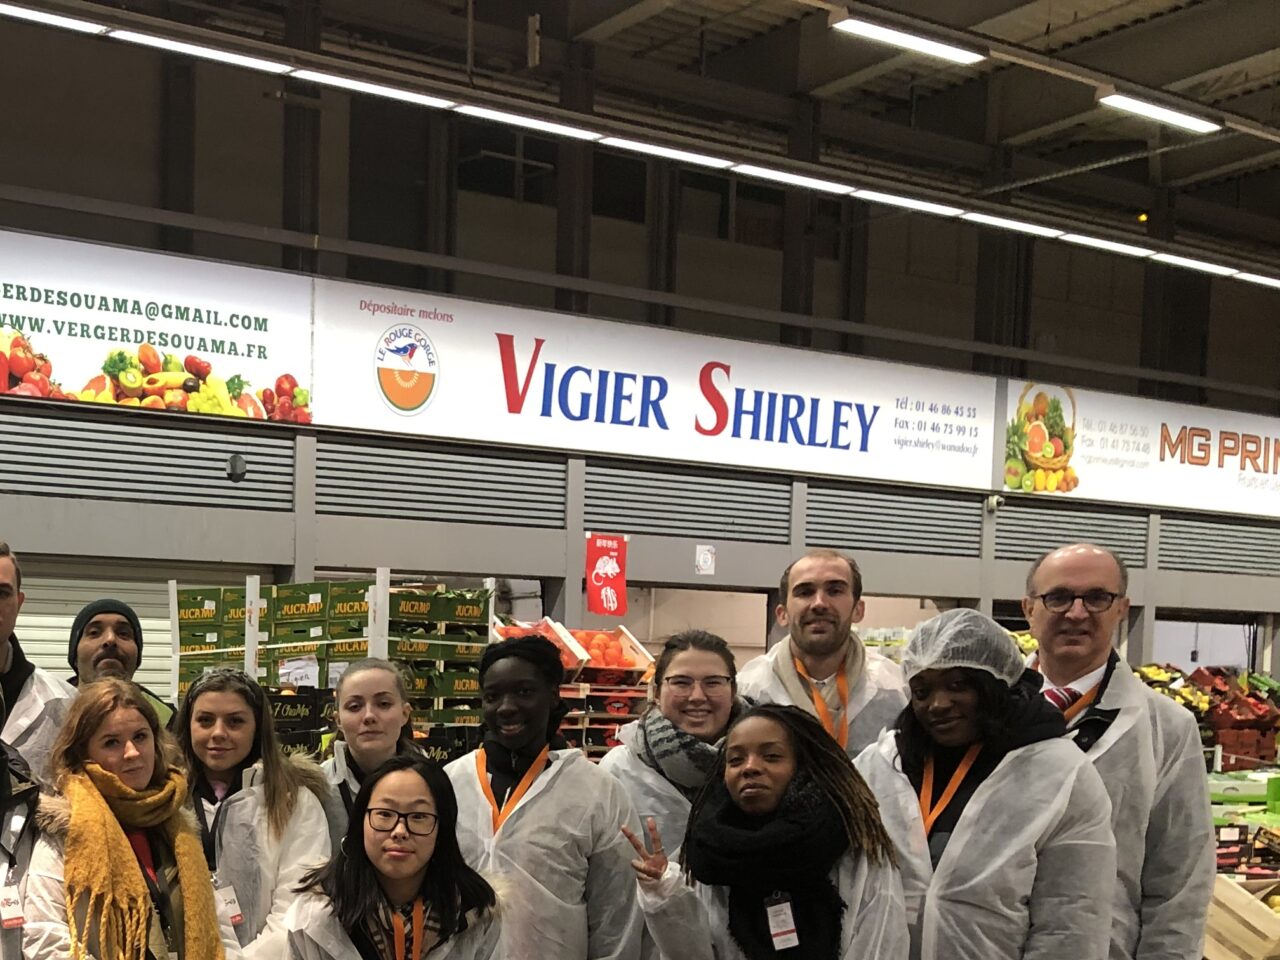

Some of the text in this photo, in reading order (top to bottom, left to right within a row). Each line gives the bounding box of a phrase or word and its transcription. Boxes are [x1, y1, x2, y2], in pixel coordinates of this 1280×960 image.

[359, 299, 454, 323] Dépositaire melons
[377, 328, 436, 367] LE ROUGE GORGE
[495, 332, 880, 453] VIGIER SHIRLEY
[915, 400, 925, 412] 01
[917, 420, 927, 432] 01
[1160, 422, 1280, 475] MG PRI
[281, 602, 323, 616] JUCAMP
[334, 601, 369, 614] JUCAM
[333, 640, 369, 652] JUCAM
